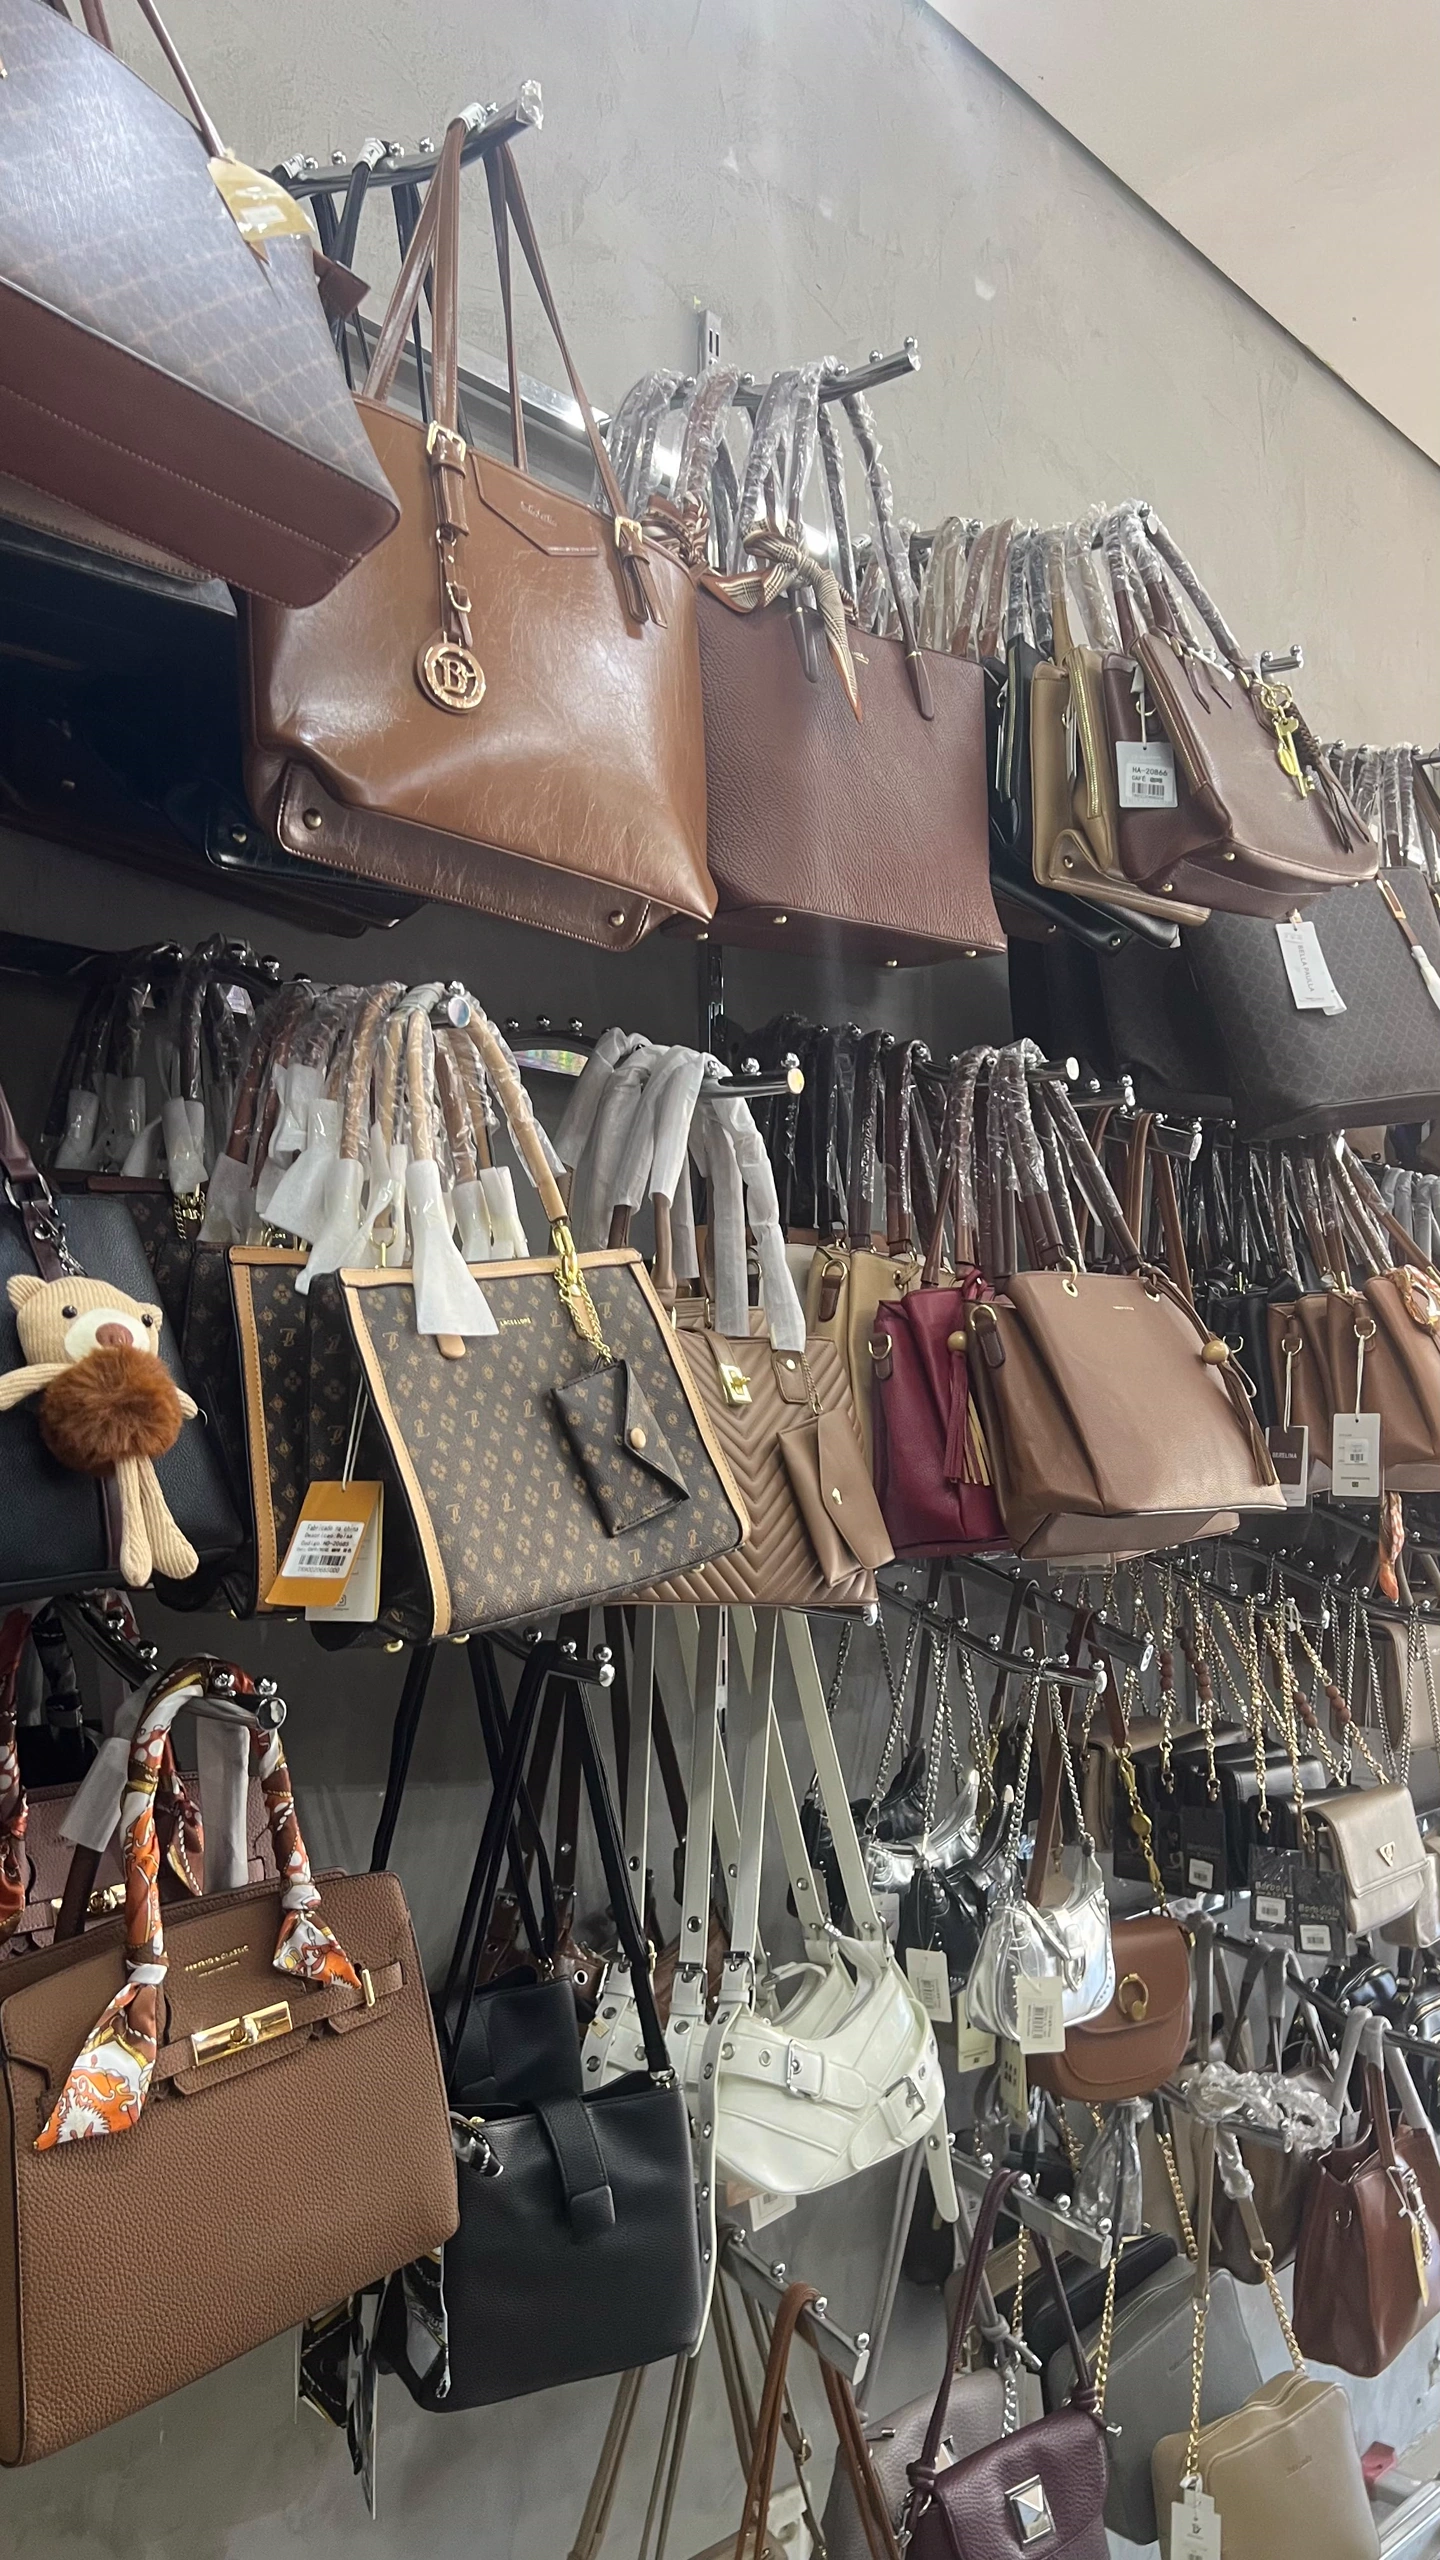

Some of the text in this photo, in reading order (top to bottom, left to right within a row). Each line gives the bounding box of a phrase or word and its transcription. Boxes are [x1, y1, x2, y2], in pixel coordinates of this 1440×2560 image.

[1297, 944, 1308, 967] BELLA
[1303, 967, 1315, 992] PAULLA
[307, 1524, 333, 1532] Fabricado
[221, 1945, 249, 1959] CLASSIC
